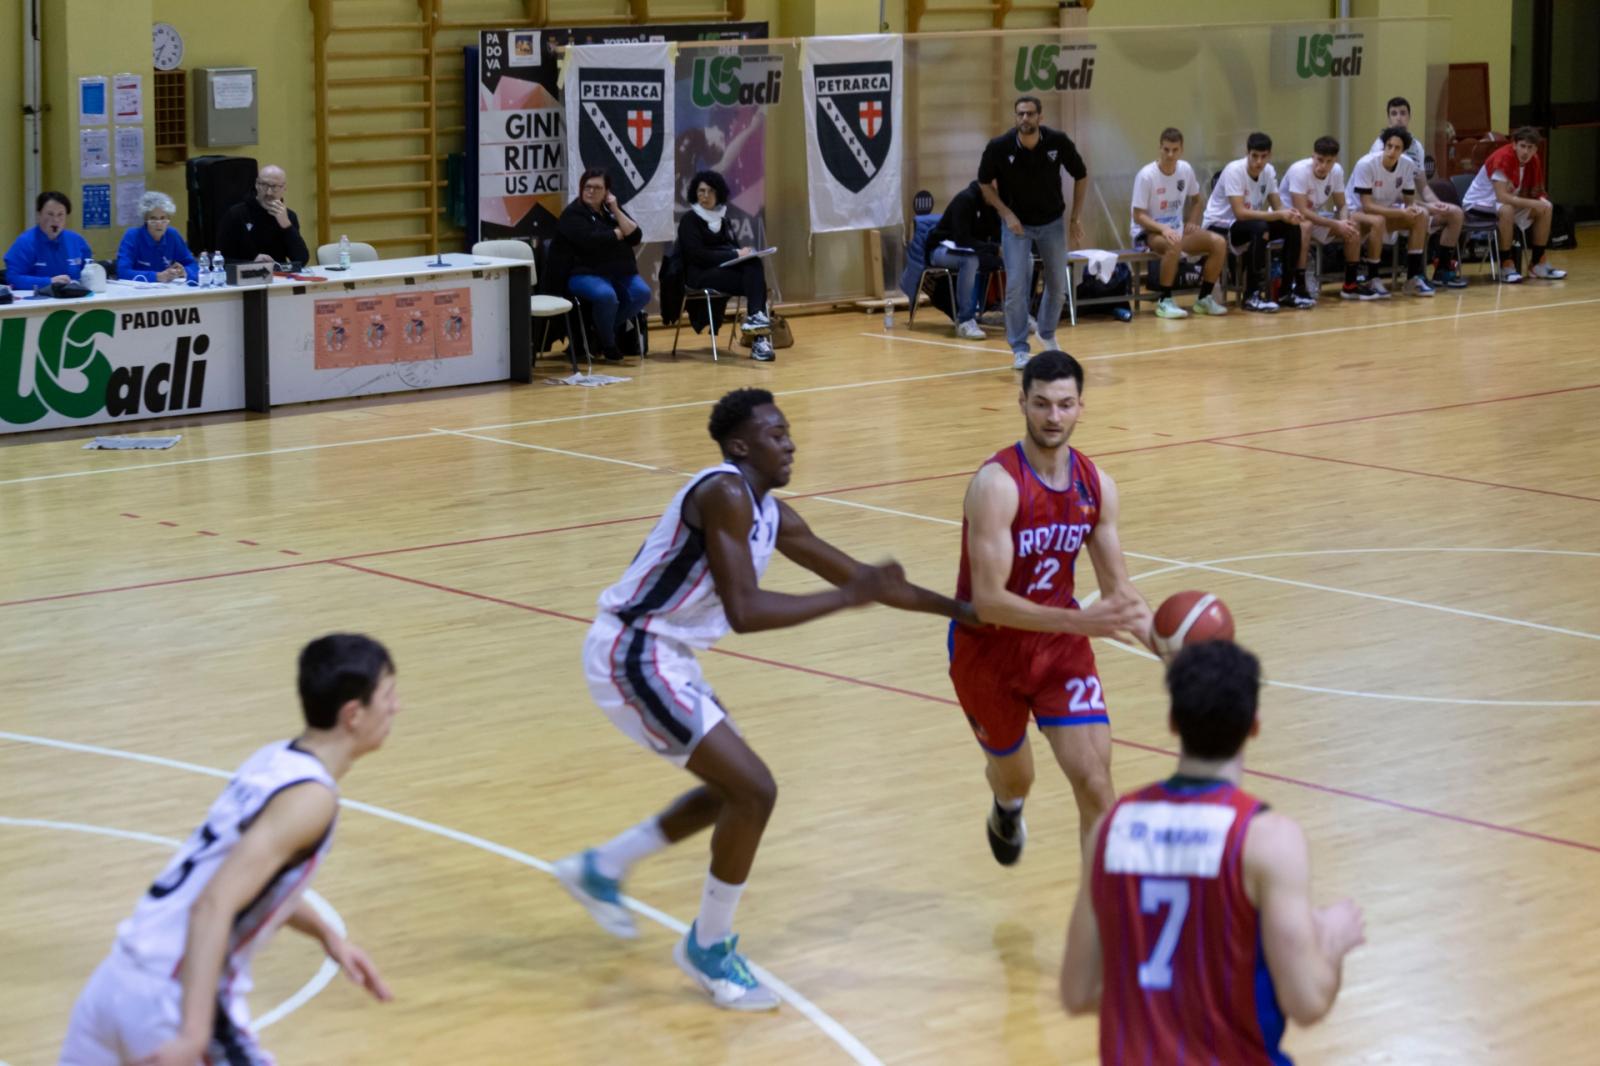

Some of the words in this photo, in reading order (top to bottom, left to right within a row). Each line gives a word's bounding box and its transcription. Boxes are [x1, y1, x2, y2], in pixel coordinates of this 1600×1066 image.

[583, 84, 659, 98] PETRARCA
[818, 76, 888, 92] PETRARCA
[591, 107, 637, 179] BASKET
[826, 102, 869, 168] BASKET
[505, 176, 528, 194] US
[121, 307, 201, 330] PADOVA
[1065, 675, 1106, 712] 22
[1138, 878, 1190, 990] 7
